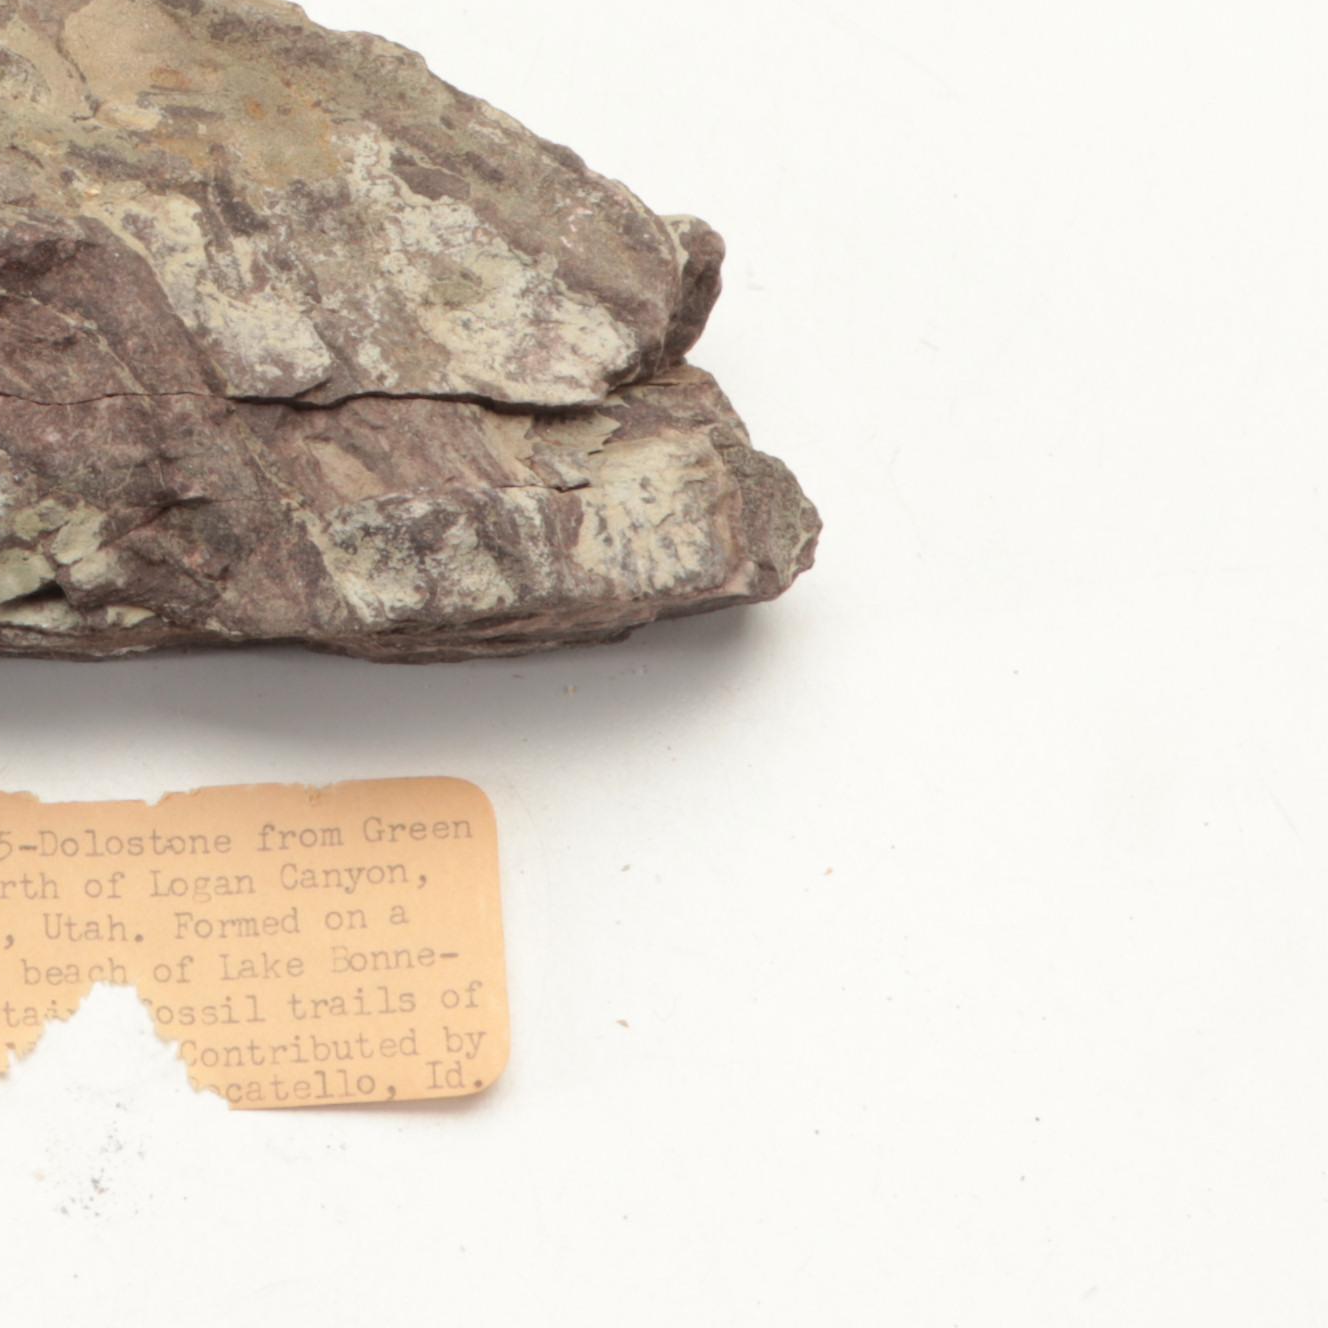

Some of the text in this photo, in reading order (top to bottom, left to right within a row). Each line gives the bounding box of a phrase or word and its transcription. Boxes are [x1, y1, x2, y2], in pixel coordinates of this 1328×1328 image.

[257, 823, 343, 852] from
[363, 817, 473, 843] Green
[84, 871, 126, 899] of
[148, 869, 256, 904] Logan
[280, 863, 428, 895] Canyon,
[42, 912, 145, 943] Utah.
[174, 906, 301, 940] Formed
[324, 909, 368, 931] on
[389, 904, 409, 925] a
[21, 958, 128, 987] beach
[153, 955, 195, 984] of
[219, 951, 304, 981] Lake
[330, 945, 461, 974] Bonne-
[287, 986, 417, 1021] trails
[441, 980, 483, 1009] of
[181, 1027, 419, 1068] Contributed
[442, 1025, 487, 1060] by
[426, 1060, 485, 1091] Id.
